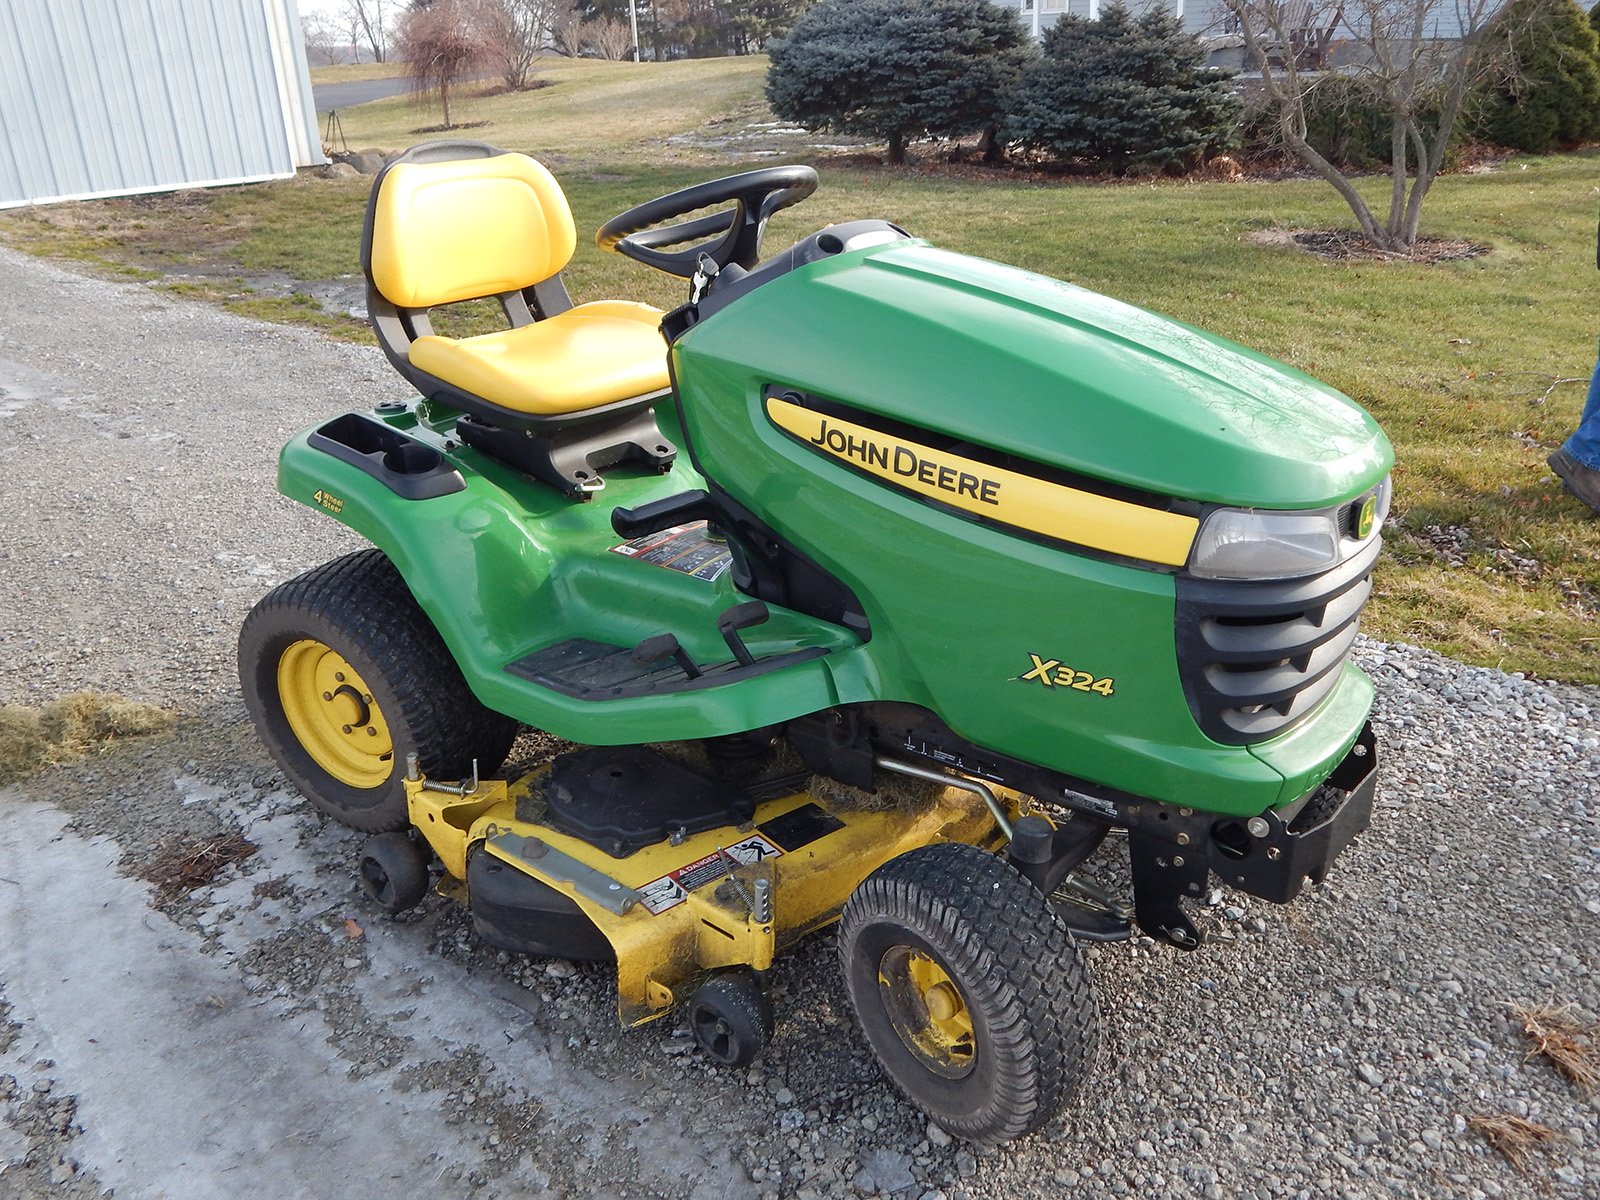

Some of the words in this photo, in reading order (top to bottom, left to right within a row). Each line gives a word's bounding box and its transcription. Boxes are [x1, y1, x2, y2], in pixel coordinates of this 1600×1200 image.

[811, 420, 888, 469] JOHN
[894, 446, 1001, 505] DEERE
[313, 489, 323, 504] 4
[323, 492, 344, 508] Wheel
[322, 500, 342, 514] Steer
[1020, 653, 1115, 697] X324
[686, 854, 720, 873] DANGER
